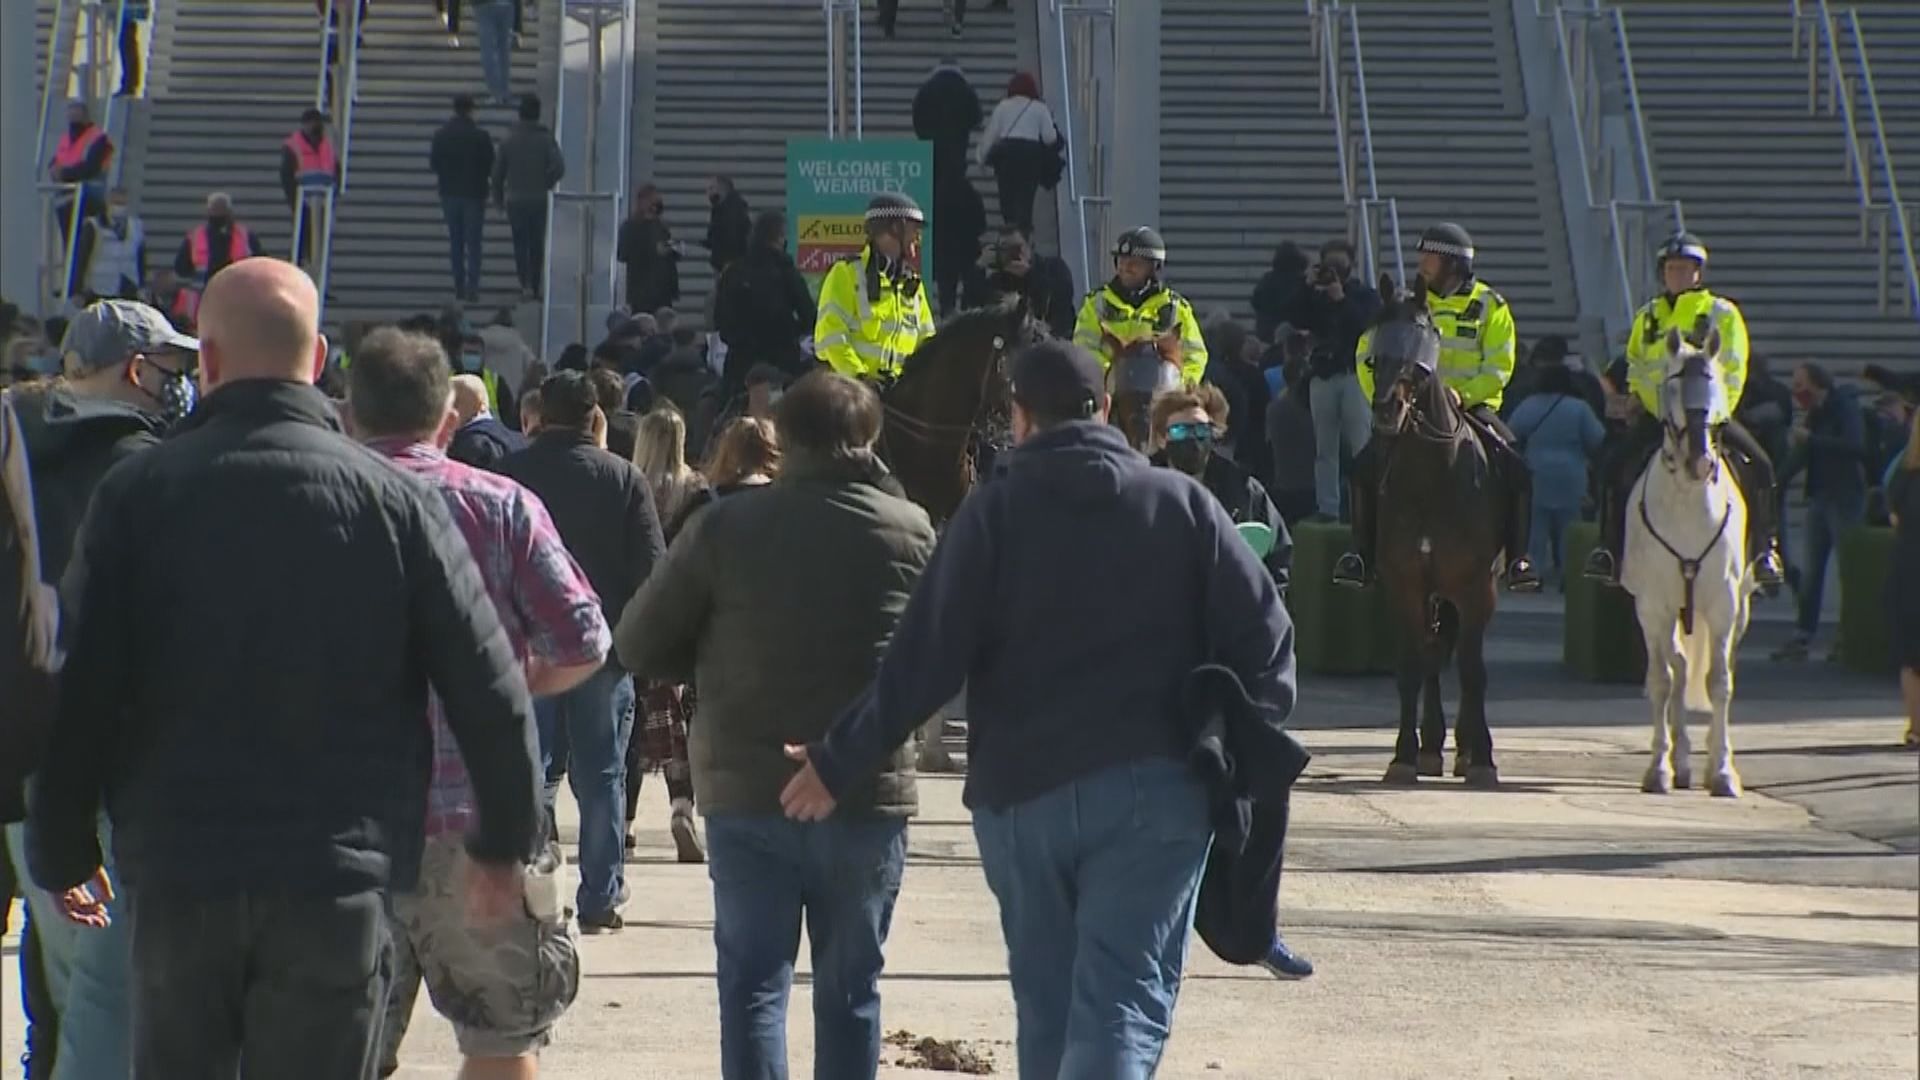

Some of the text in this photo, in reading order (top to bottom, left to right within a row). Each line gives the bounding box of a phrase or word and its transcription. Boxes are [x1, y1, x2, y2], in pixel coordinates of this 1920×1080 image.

[798, 160, 921, 177] WELCOME TO
[813, 178, 906, 193] WEMBLEY
[823, 223, 864, 235] YELLO
